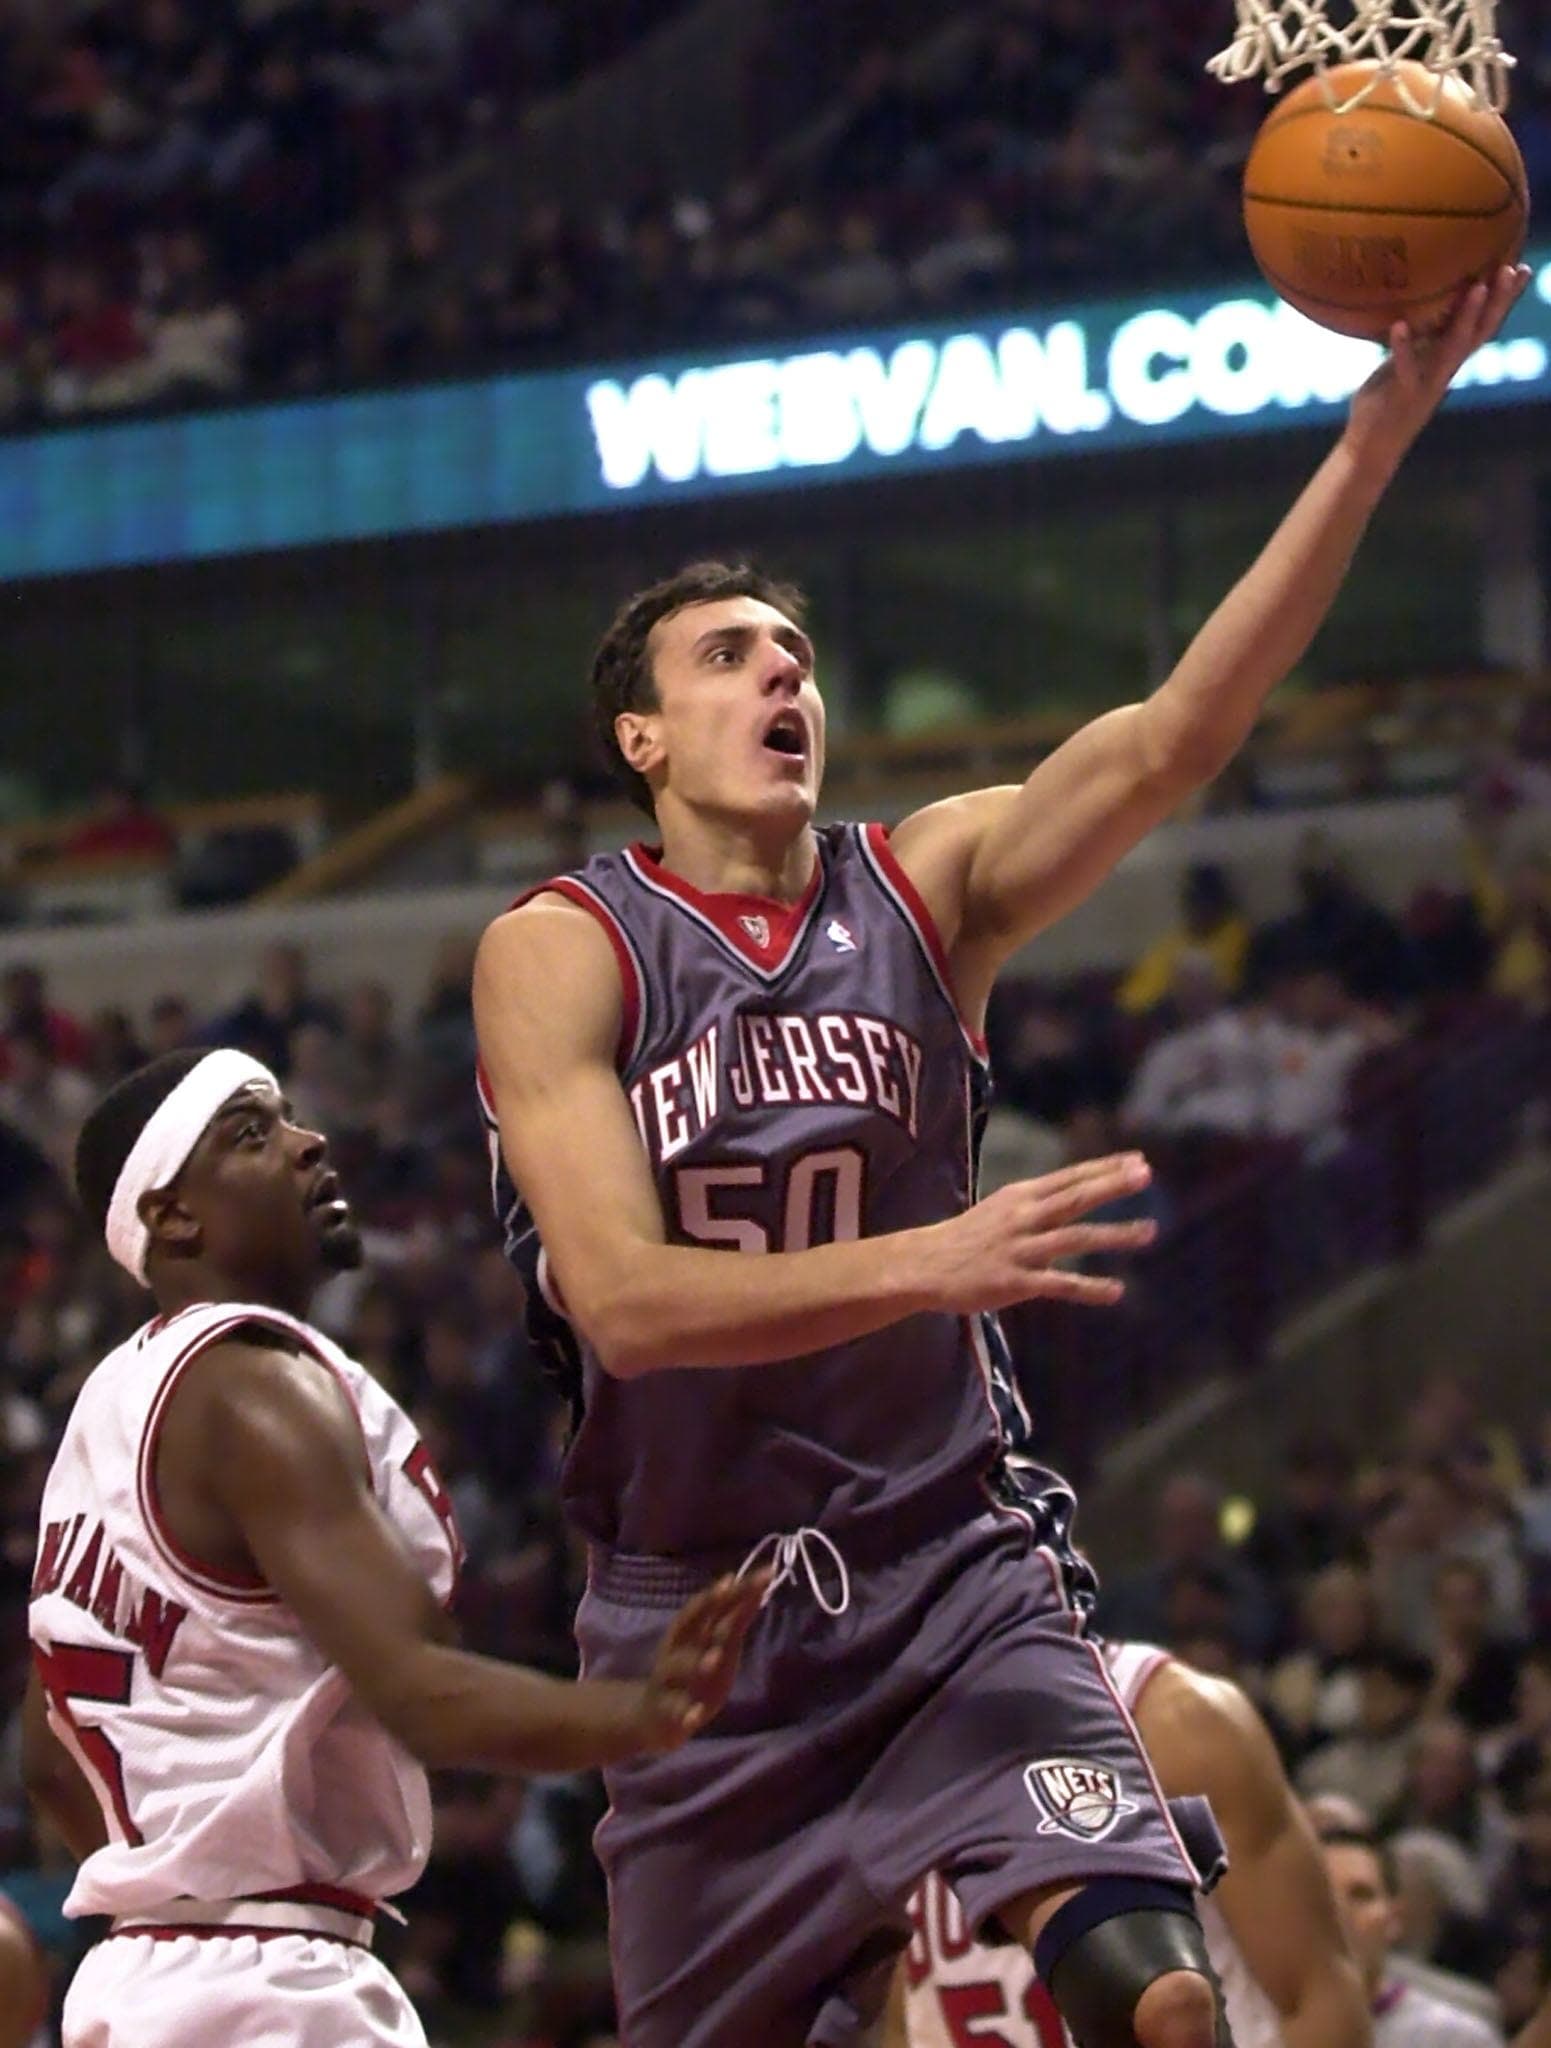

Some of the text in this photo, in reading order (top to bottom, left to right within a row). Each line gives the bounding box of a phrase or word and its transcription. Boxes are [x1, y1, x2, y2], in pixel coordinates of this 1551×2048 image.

[730, 1014, 923, 1138] JERSEY
[678, 1149, 863, 1254] 50
[1040, 1767, 1114, 1810] NETS
